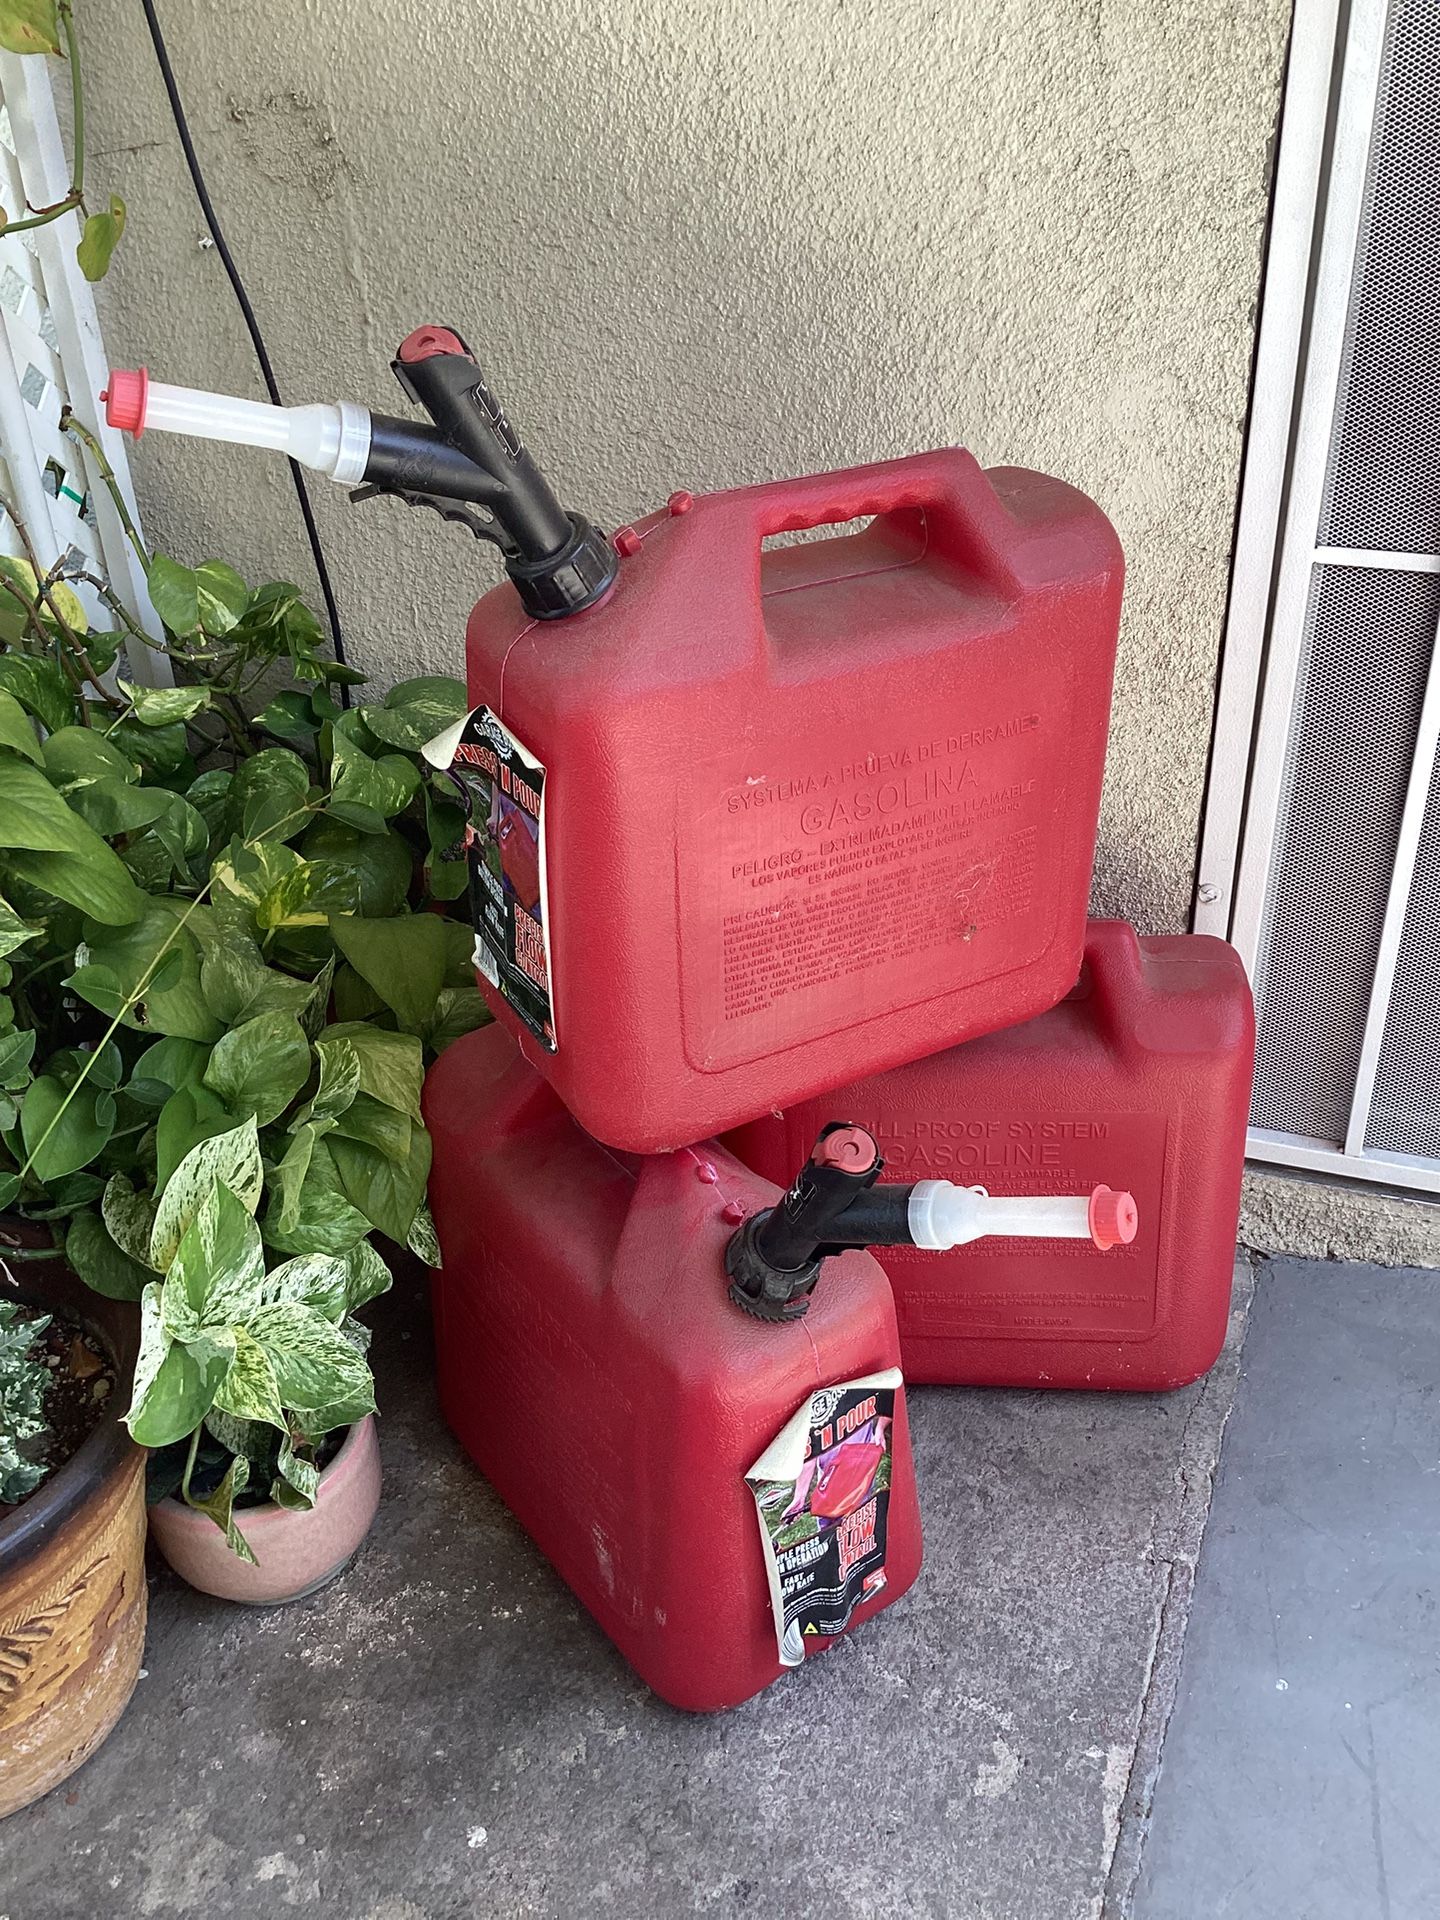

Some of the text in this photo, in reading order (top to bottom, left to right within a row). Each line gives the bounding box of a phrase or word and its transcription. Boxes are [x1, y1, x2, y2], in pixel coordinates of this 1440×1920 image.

[728, 775, 820, 814] SYSTEMA
[919, 741, 942, 761] DE
[801, 760, 978, 836] GASOLINA
[732, 849, 803, 879] PELIGRO
[751, 873, 774, 888] LOS
[776, 861, 827, 882] VAPORES
[1008, 1121, 1110, 1139] SYSTEM
[883, 1143, 1061, 1167] GASOLINE
[929, 1169, 998, 1181] EXTREMELY
[1001, 1168, 1076, 1179] FLAMMABLE
[836, 1396, 877, 1441] POUR
[786, 1542, 829, 1571] OPERATION
[795, 1536, 819, 1556] PRESS
[784, 1571, 805, 1587] FAST
[796, 1572, 816, 1591] RATE
